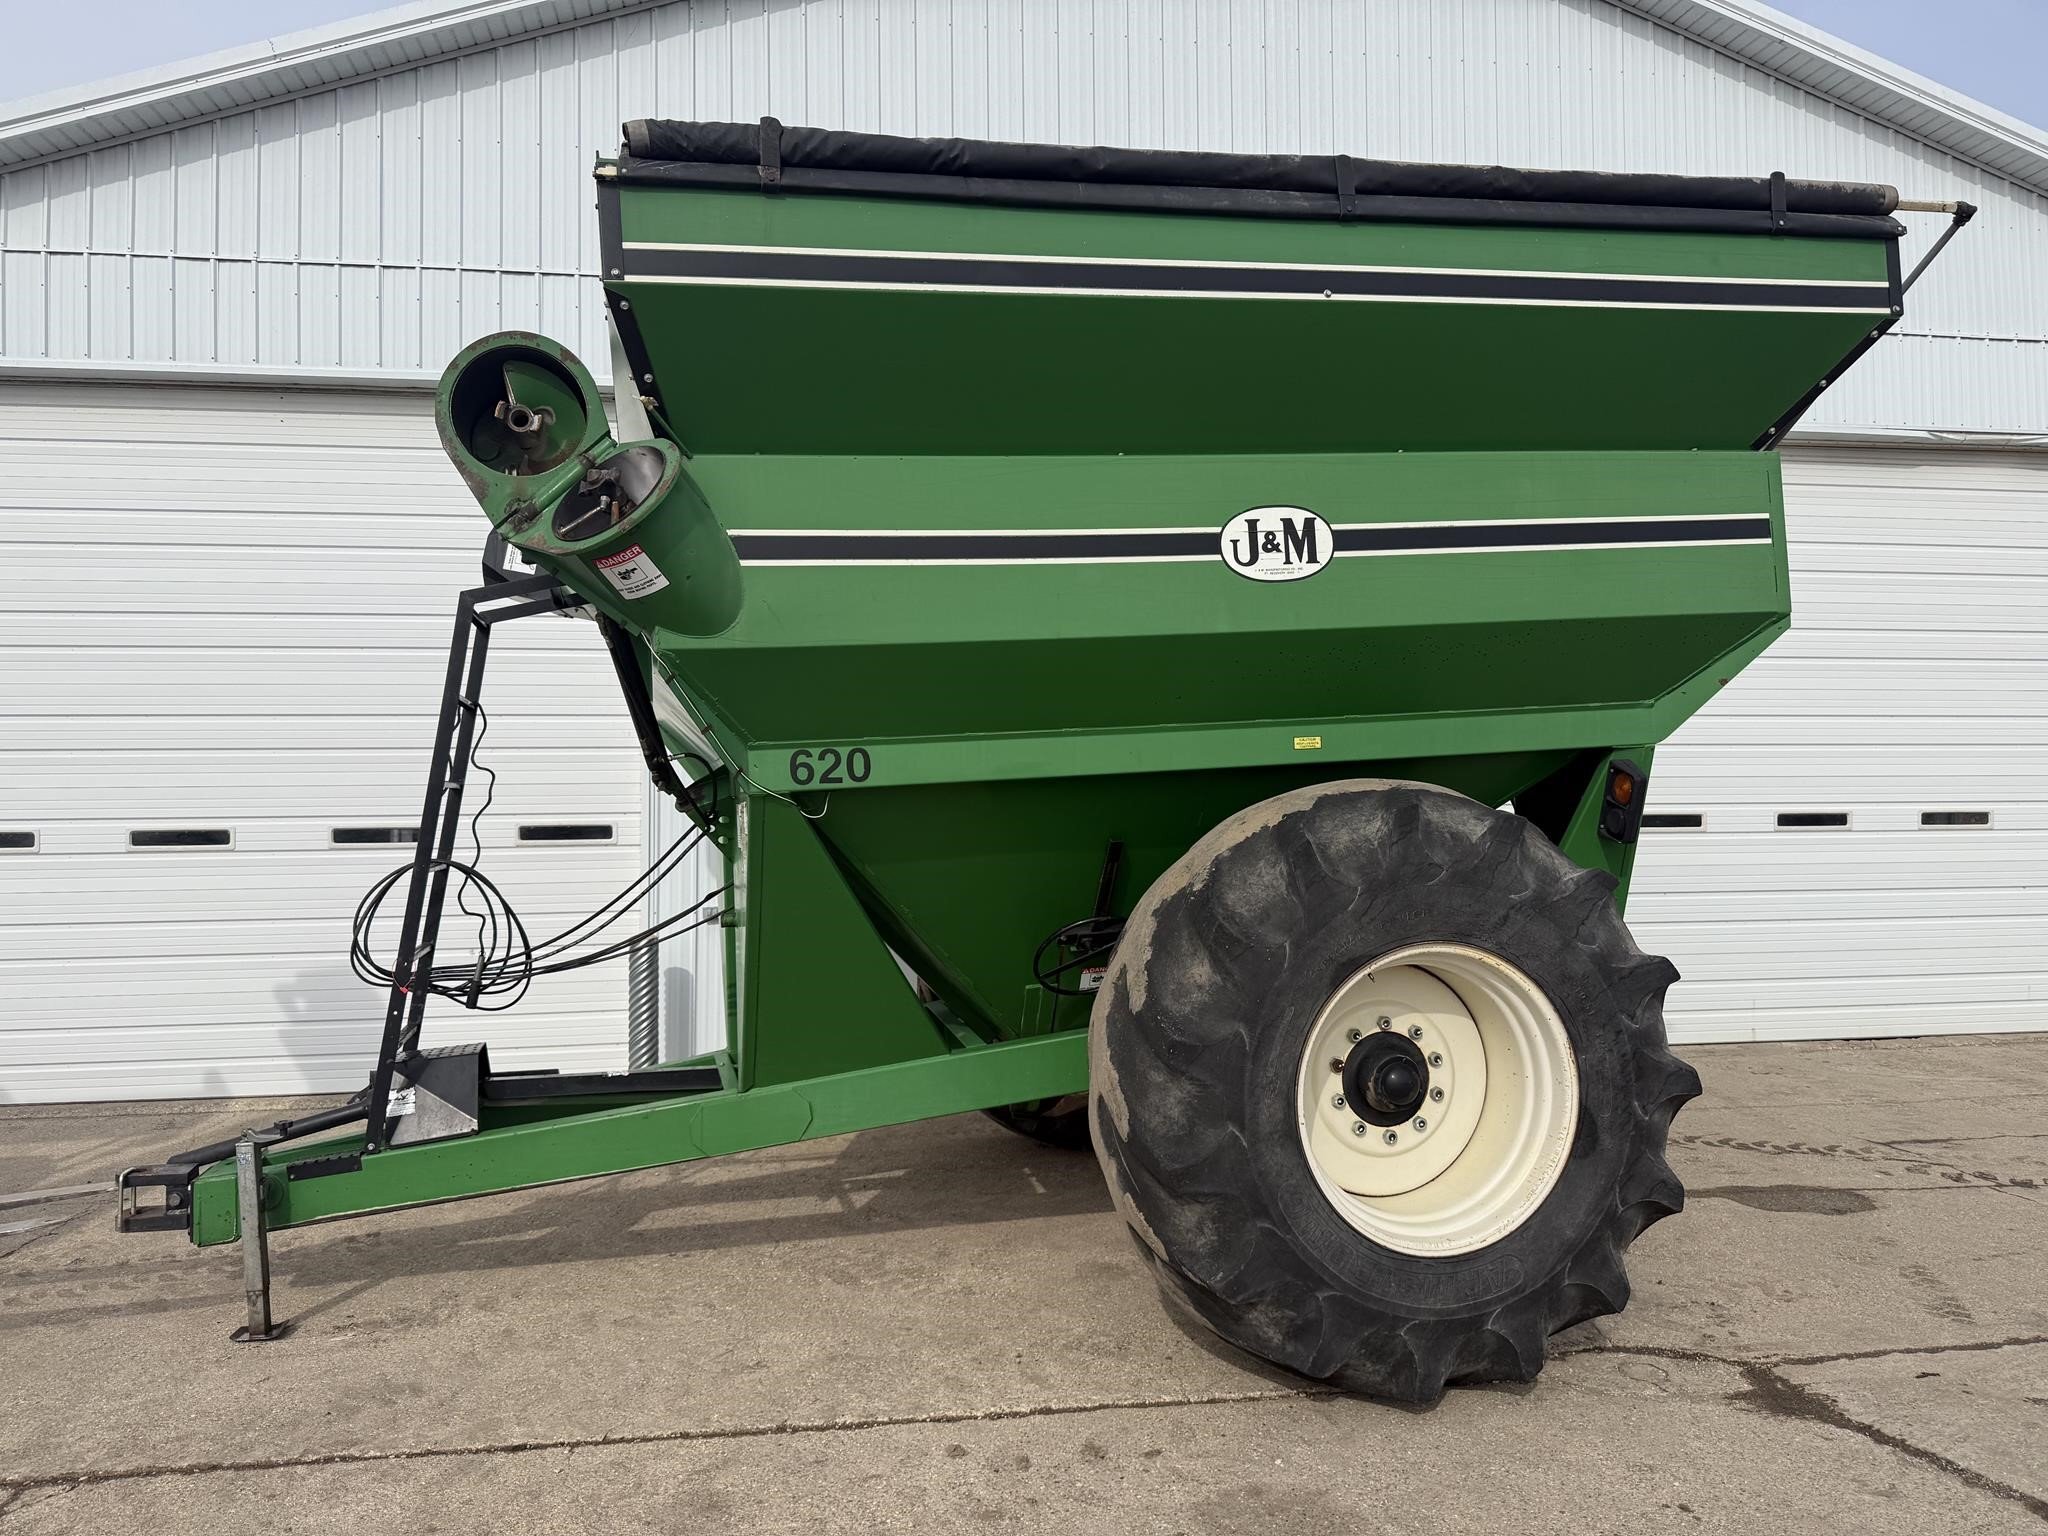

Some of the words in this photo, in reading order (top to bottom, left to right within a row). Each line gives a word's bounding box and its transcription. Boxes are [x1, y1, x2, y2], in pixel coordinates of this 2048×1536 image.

[603, 546, 642, 567] DANGER
[1230, 518, 1320, 567] J&M
[790, 747, 871, 785] 620
